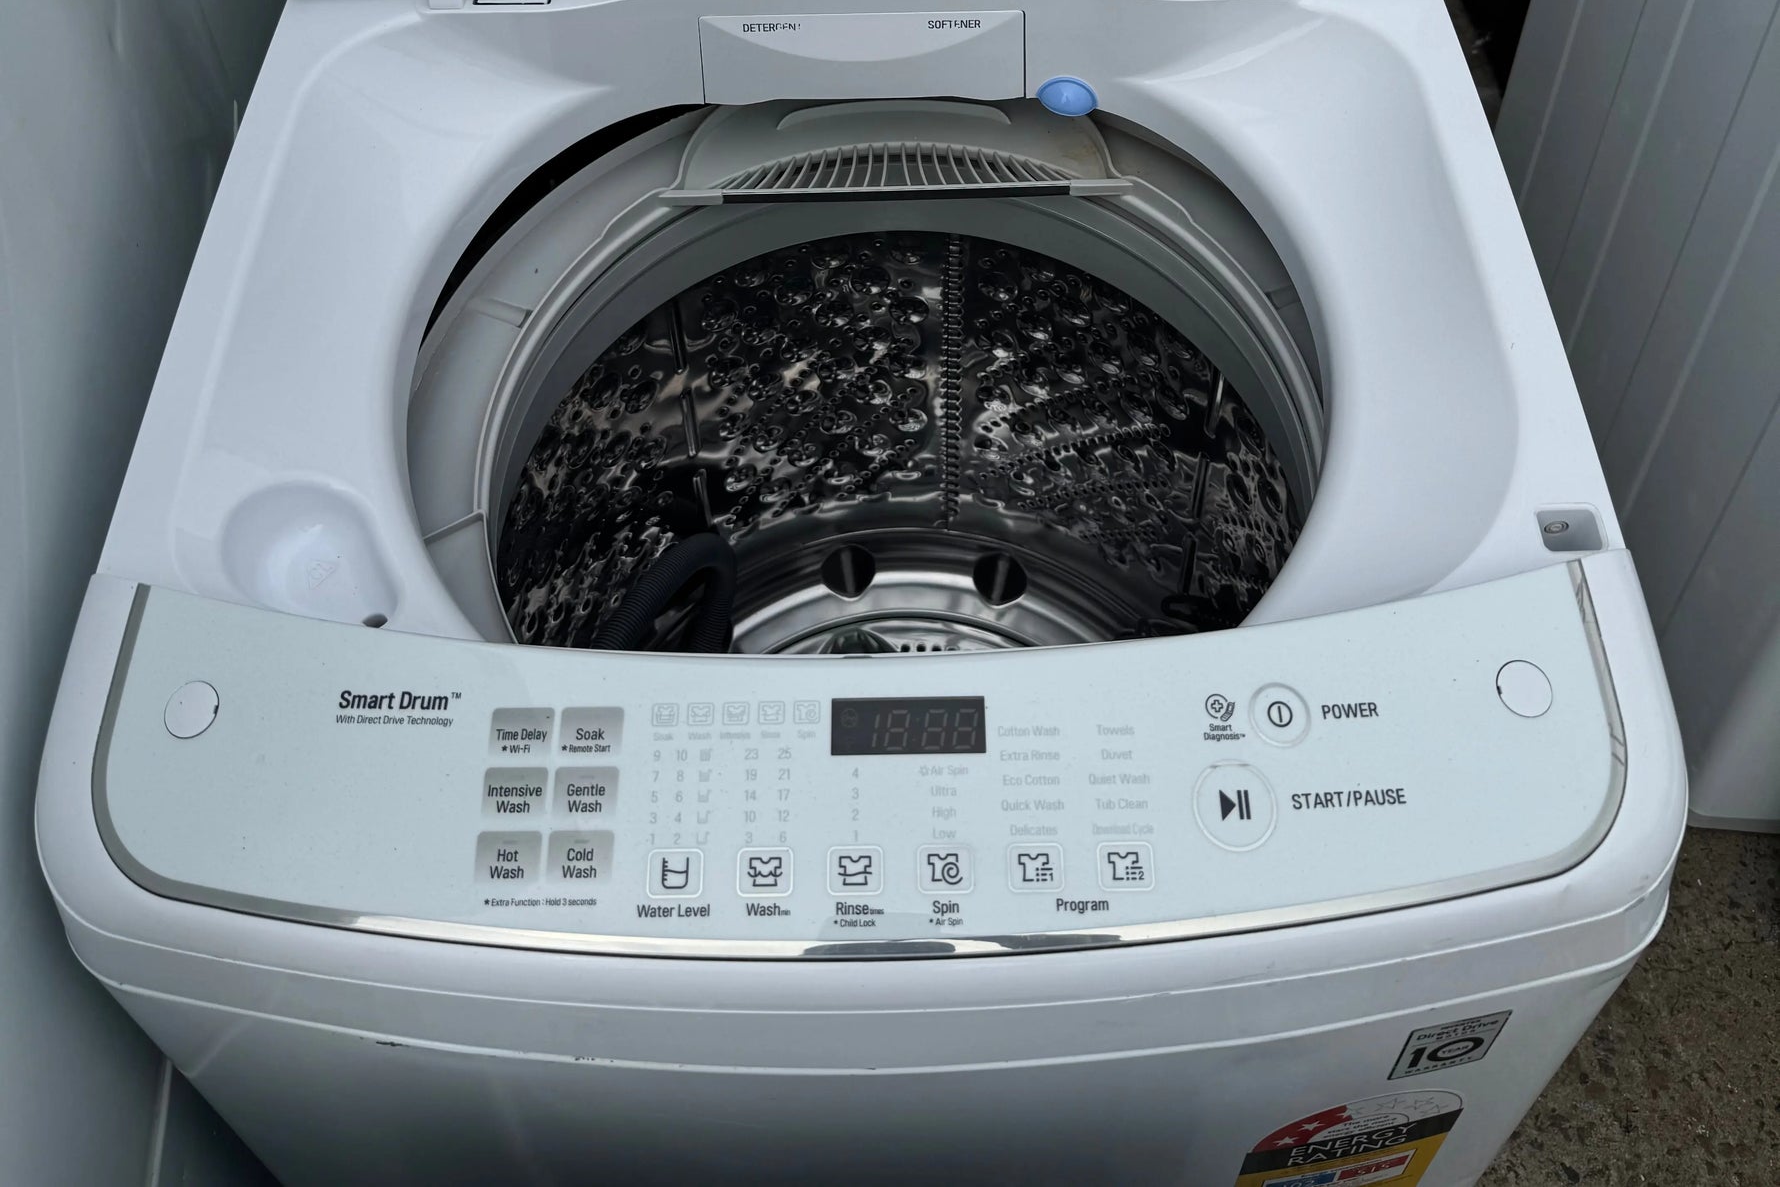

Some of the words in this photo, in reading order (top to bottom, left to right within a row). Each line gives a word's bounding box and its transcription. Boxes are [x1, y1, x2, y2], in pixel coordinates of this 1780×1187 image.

[338, 690, 395, 709] Smart
[1321, 701, 1379, 720] POWER
[336, 714, 356, 725] With
[357, 714, 382, 725] Direct
[383, 715, 405, 726] Drive
[407, 715, 454, 727] Technology
[576, 727, 605, 741] Soak
[997, 725, 1030, 737] Cotton
[1032, 725, 1060, 736] Wash
[1096, 724, 1135, 736] Towels
[1209, 723, 1233, 732] Smart
[496, 728, 519, 741] Time
[521, 728, 548, 743] Delay
[509, 744, 531, 754] Wi-Fi
[569, 744, 593, 753] Remote
[594, 743, 611, 752] Start
[744, 748, 759, 760] 23
[778, 747, 792, 760] 25
[1101, 748, 1133, 760] Duvet
[653, 750, 661, 761] 9
[676, 749, 688, 761] 10
[1000, 750, 1029, 761] Extra
[1031, 749, 1060, 761] Rinse
[652, 770, 659, 782] 7
[676, 769, 684, 782] 8
[745, 769, 757, 781] 19
[778, 768, 791, 781] 21
[851, 767, 859, 779] 4
[931, 765, 944, 776] Air
[947, 765, 968, 777] Spin
[1002, 774, 1022, 786] Eco
[1024, 774, 1060, 786] Cotton
[1088, 773, 1116, 785] Quiet
[1118, 773, 1151, 785] Wash
[487, 784, 543, 797] Intensive
[566, 783, 606, 797] Gentle
[651, 790, 658, 803] 5
[675, 790, 683, 803] 6
[744, 789, 757, 801] 14
[778, 789, 790, 801] 17
[851, 788, 859, 799] 3
[931, 785, 957, 797] Ultra
[1001, 799, 1031, 812] Quick
[1034, 799, 1064, 811] Wash
[1095, 798, 1115, 810] Tub
[1118, 798, 1148, 810] Clean
[1291, 788, 1407, 810] START/PAUSE
[496, 800, 530, 814] Wash
[567, 800, 602, 813] Wash
[932, 806, 956, 820] High
[650, 812, 657, 824] 3
[674, 812, 682, 823] 4
[744, 810, 757, 823] 10
[778, 809, 790, 822] 12
[851, 809, 859, 821] 2
[932, 828, 956, 840] Low
[1010, 824, 1058, 836] Delicates
[673, 833, 681, 845] 2
[745, 832, 753, 844] 3
[779, 831, 787, 843] 6
[497, 849, 519, 862] Hot
[566, 848, 594, 862] Cold
[489, 865, 524, 879] Wash
[562, 865, 597, 879] Wash
[491, 898, 509, 907] Extra
[511, 897, 540, 907] Function
[545, 897, 561, 906] Hold
[562, 897, 567, 906] 3
[568, 897, 597, 906] seconds
[932, 900, 960, 916] Spin
[1056, 897, 1110, 914] Program
[637, 904, 675, 918] Water
[678, 903, 710, 917] Level
[839, 918, 858, 927] Child
[859, 918, 876, 927] Lock
[935, 917, 946, 926] Air
[947, 917, 963, 927] Spin
[1416, 1028, 1459, 1041] Direct
[1462, 1020, 1499, 1031] Drive
[1407, 1036, 1485, 1069] 10
[1441, 1045, 1470, 1055] YEAR
[1363, 1115, 1390, 1123] more
[1371, 1117, 1398, 1125] more
[1291, 1122, 1417, 1157] ENERGY
[1287, 1134, 1408, 1166] RATING
